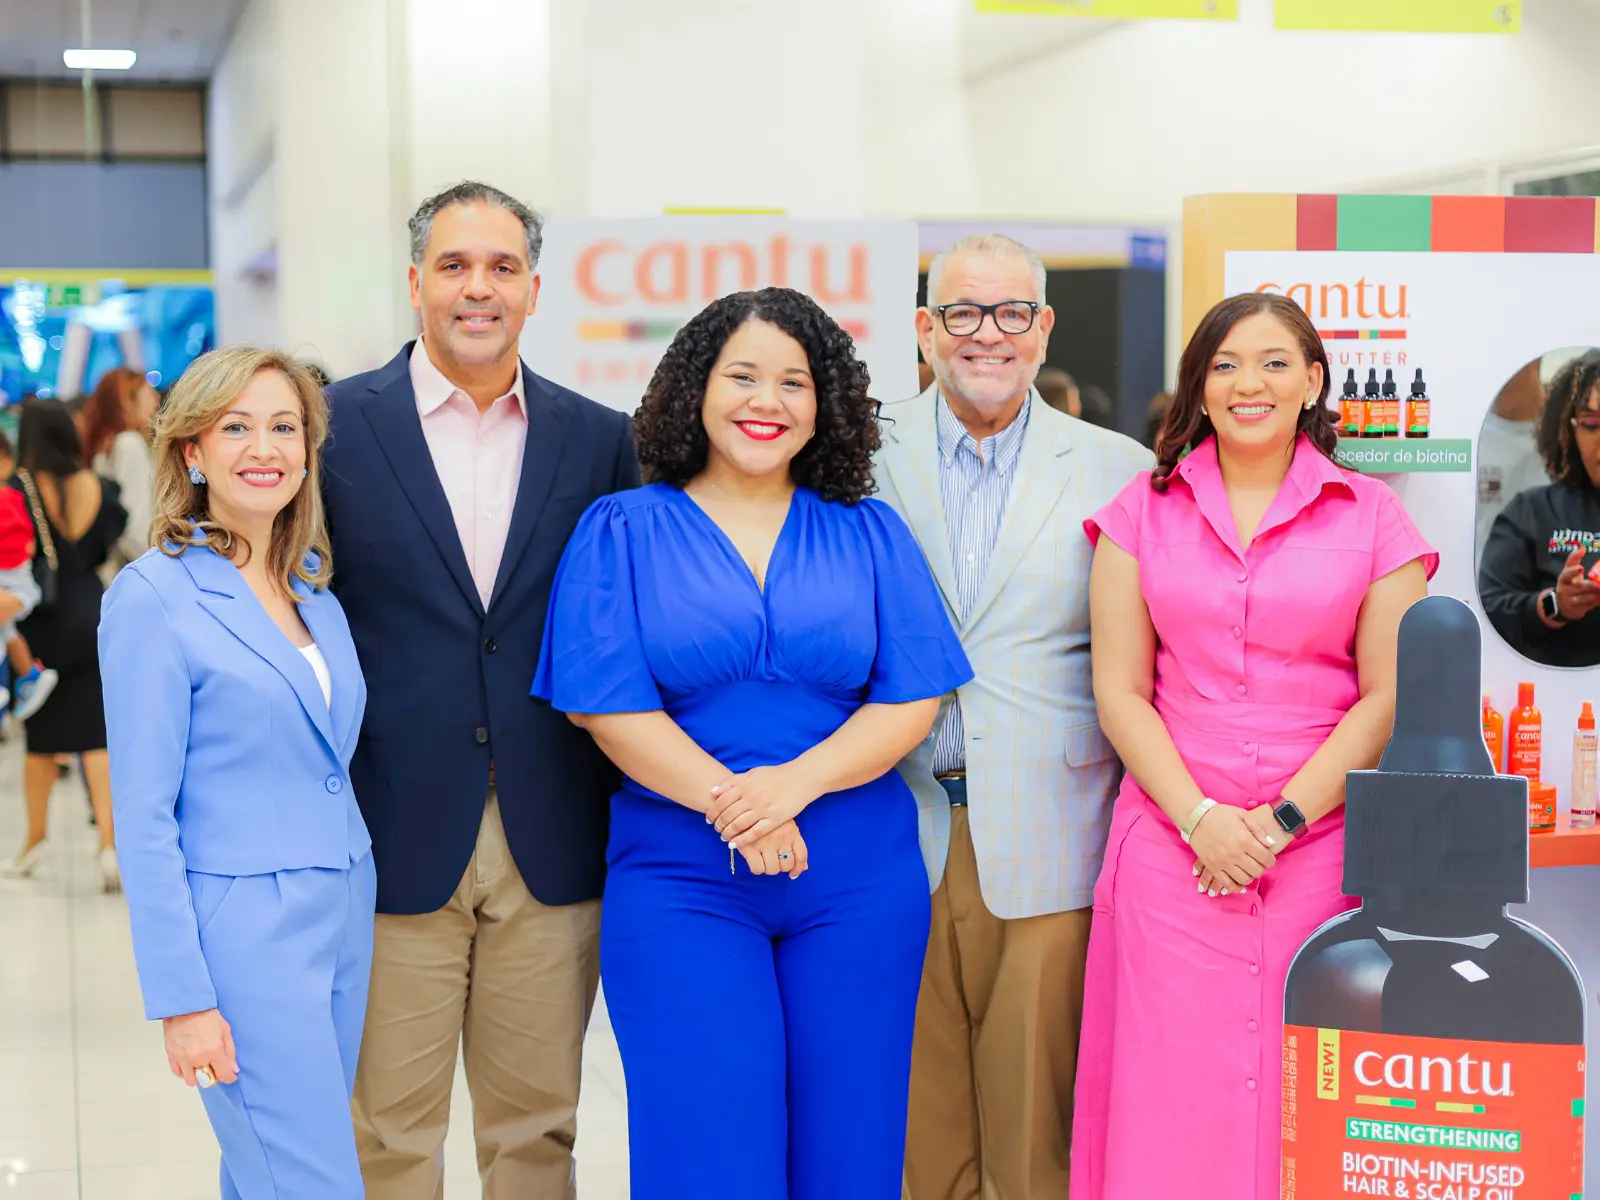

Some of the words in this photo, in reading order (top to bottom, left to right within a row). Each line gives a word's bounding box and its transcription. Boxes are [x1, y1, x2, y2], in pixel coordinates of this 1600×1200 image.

[574, 231, 871, 306] cantu
[1394, 448, 1412, 463] de
[1416, 449, 1467, 464] biotina
[1322, 1042, 1335, 1092] NEW!
[1353, 1051, 1512, 1097] cantu
[1349, 1120, 1519, 1150] STRENGTHENING
[1342, 1152, 1525, 1187] BIOTIN-INFUSED
[1343, 1174, 1388, 1196] HAIR
[1394, 1181, 1409, 1198] &
[1415, 1183, 1479, 1200] SCALP
